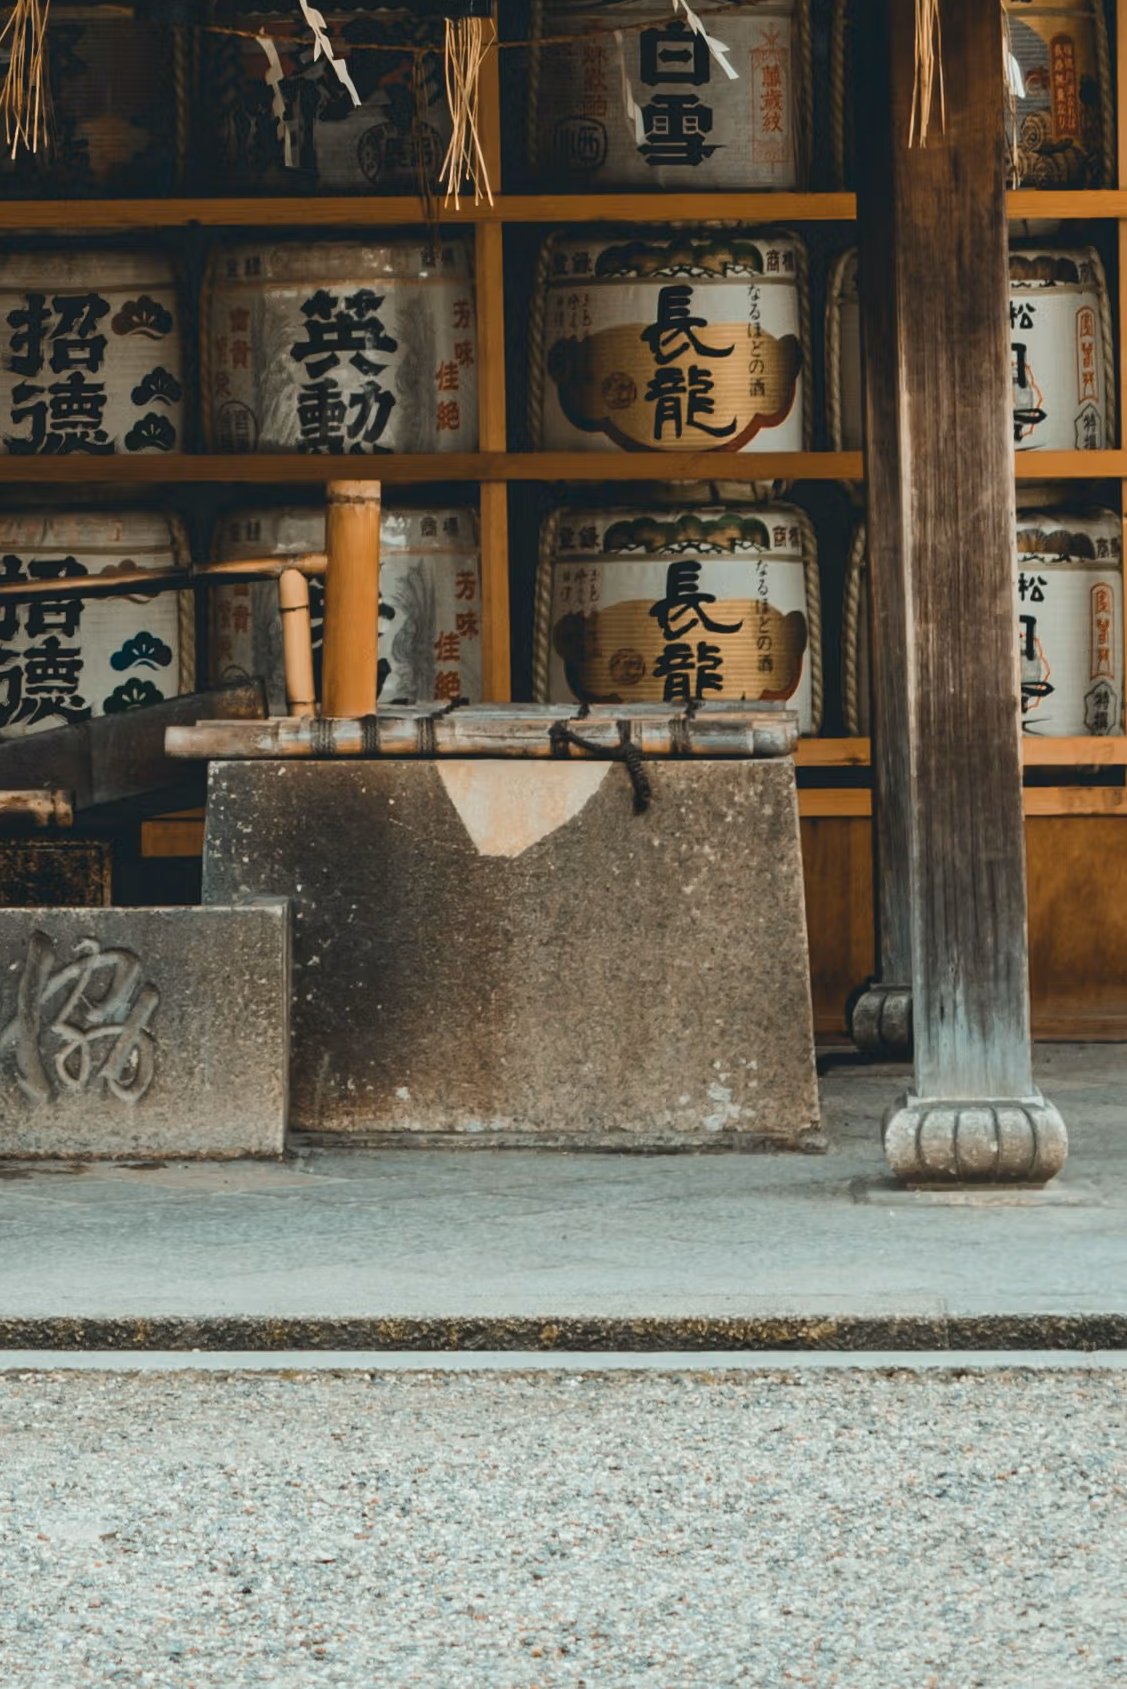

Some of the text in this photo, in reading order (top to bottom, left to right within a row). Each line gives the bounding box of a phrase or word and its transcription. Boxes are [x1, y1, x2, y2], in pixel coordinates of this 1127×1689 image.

[636, 21, 726, 166] 白雪
[641, 285, 737, 440] 長龍
[747, 284, 767, 398] なるほどの酒
[650, 560, 745, 702] 長龍
[755, 560, 775, 672] なるほどの酒
